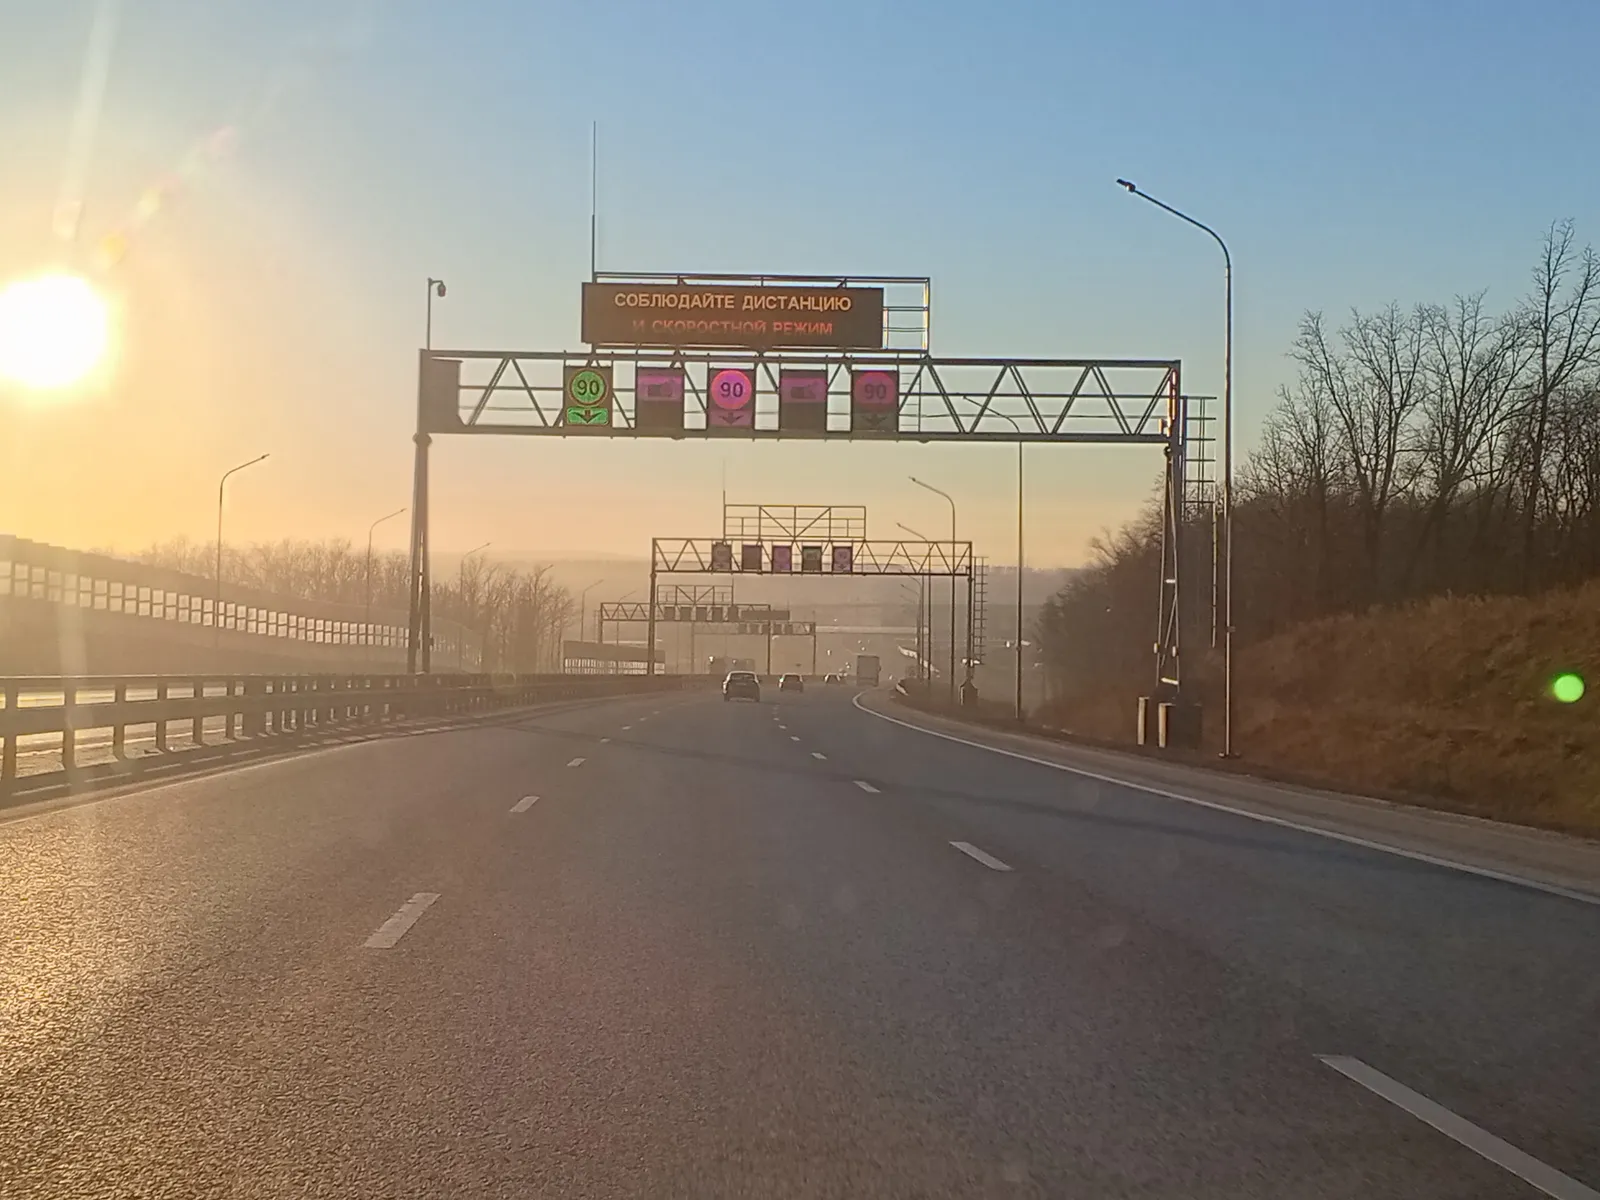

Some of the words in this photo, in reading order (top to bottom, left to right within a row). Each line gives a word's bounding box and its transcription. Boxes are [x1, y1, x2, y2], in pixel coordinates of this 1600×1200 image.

[614, 293, 735, 309] СОБЛЮДАЙТЕ
[742, 295, 852, 312] ДИСТАНЦИЮ
[633, 320, 645, 333] И
[652, 319, 766, 335] СКОРОСТНОЙ
[773, 321, 833, 336] РЕЖИМ
[577, 379, 600, 396] 90
[720, 381, 743, 398] 90
[865, 383, 887, 400] 90
